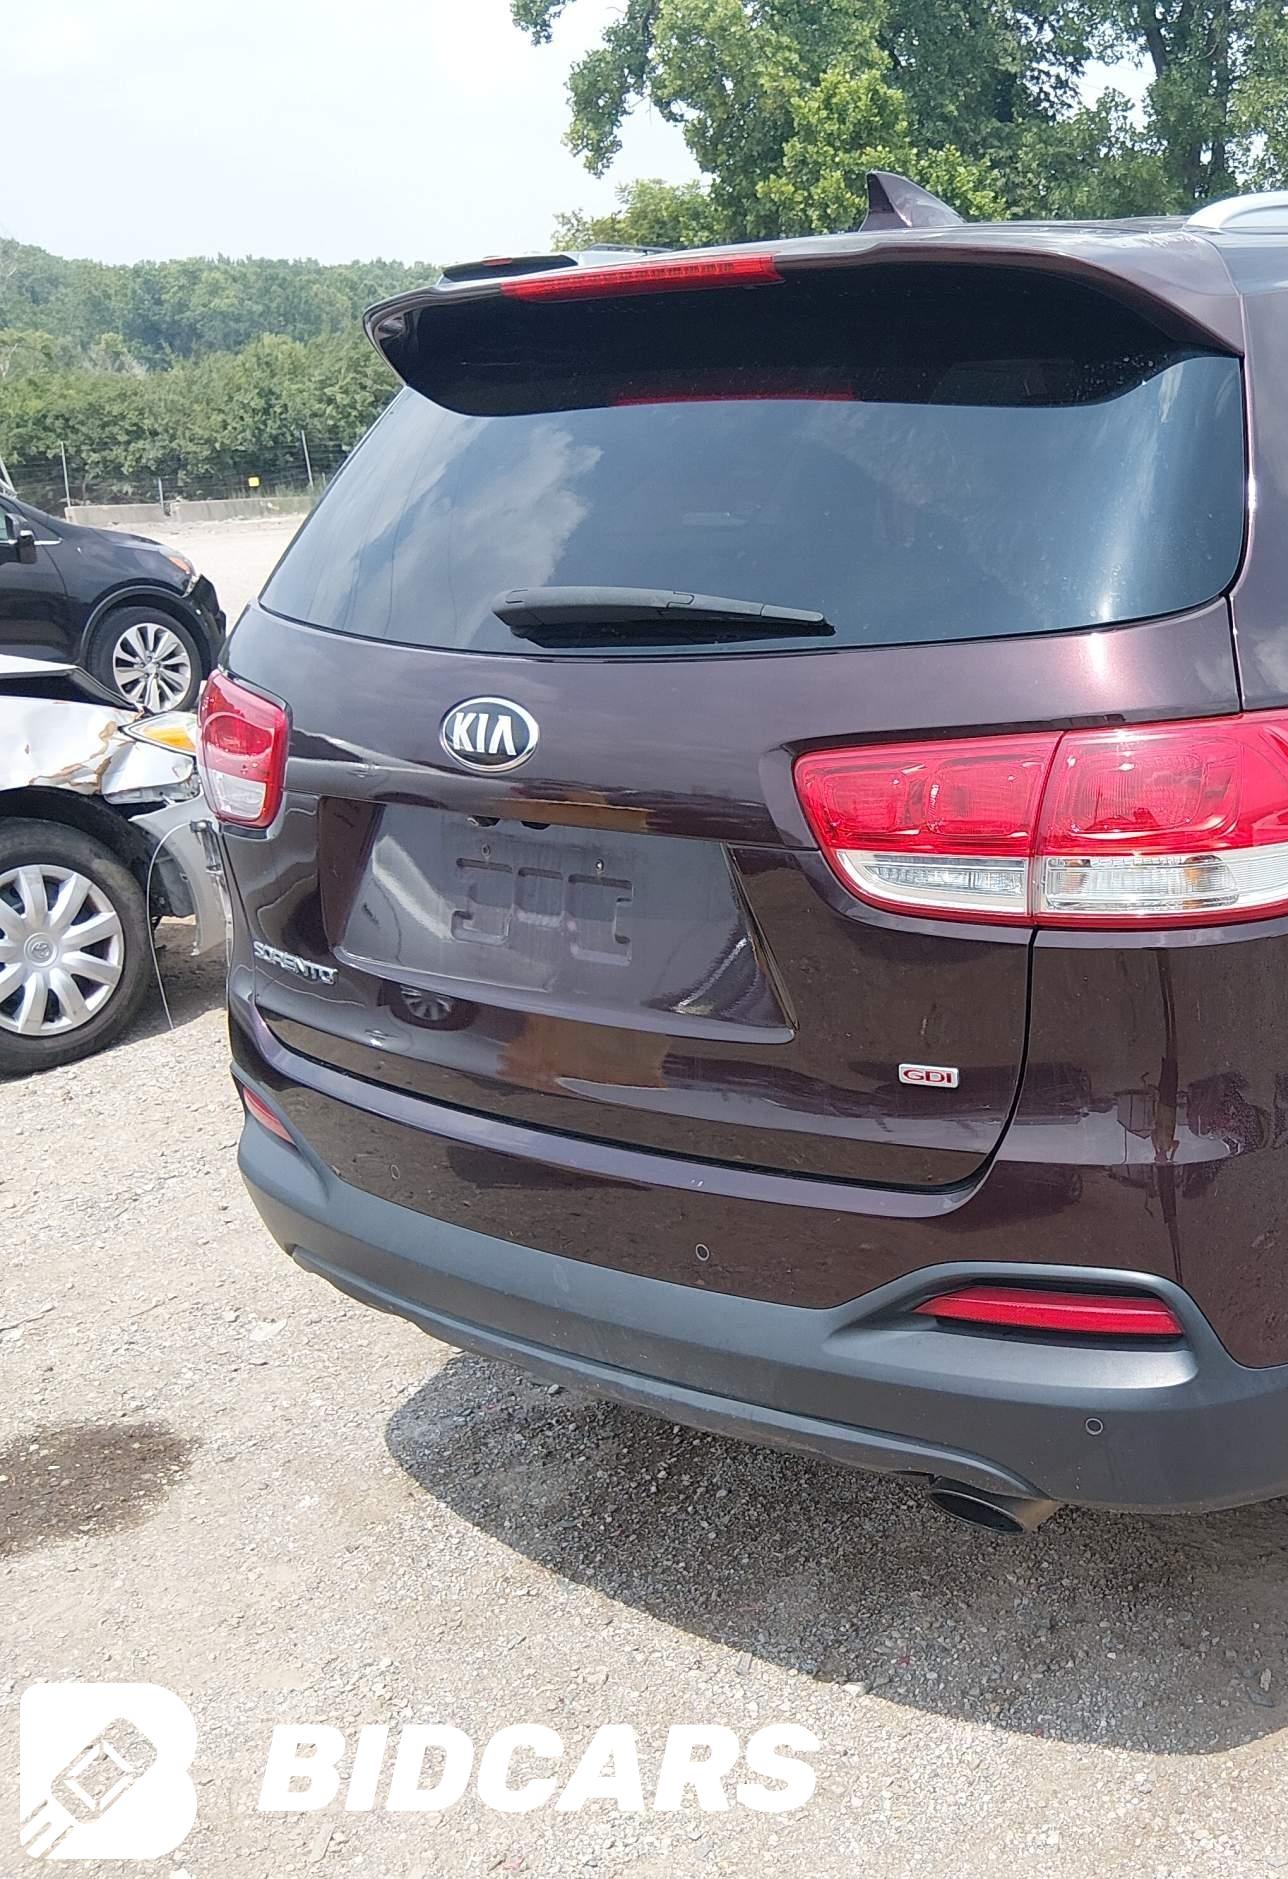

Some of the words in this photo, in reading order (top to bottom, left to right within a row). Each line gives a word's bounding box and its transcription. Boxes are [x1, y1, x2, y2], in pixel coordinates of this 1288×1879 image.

[453, 712, 517, 756] KIA
[253, 940, 339, 985] SORENTO
[903, 1069, 952, 1084] GDI
